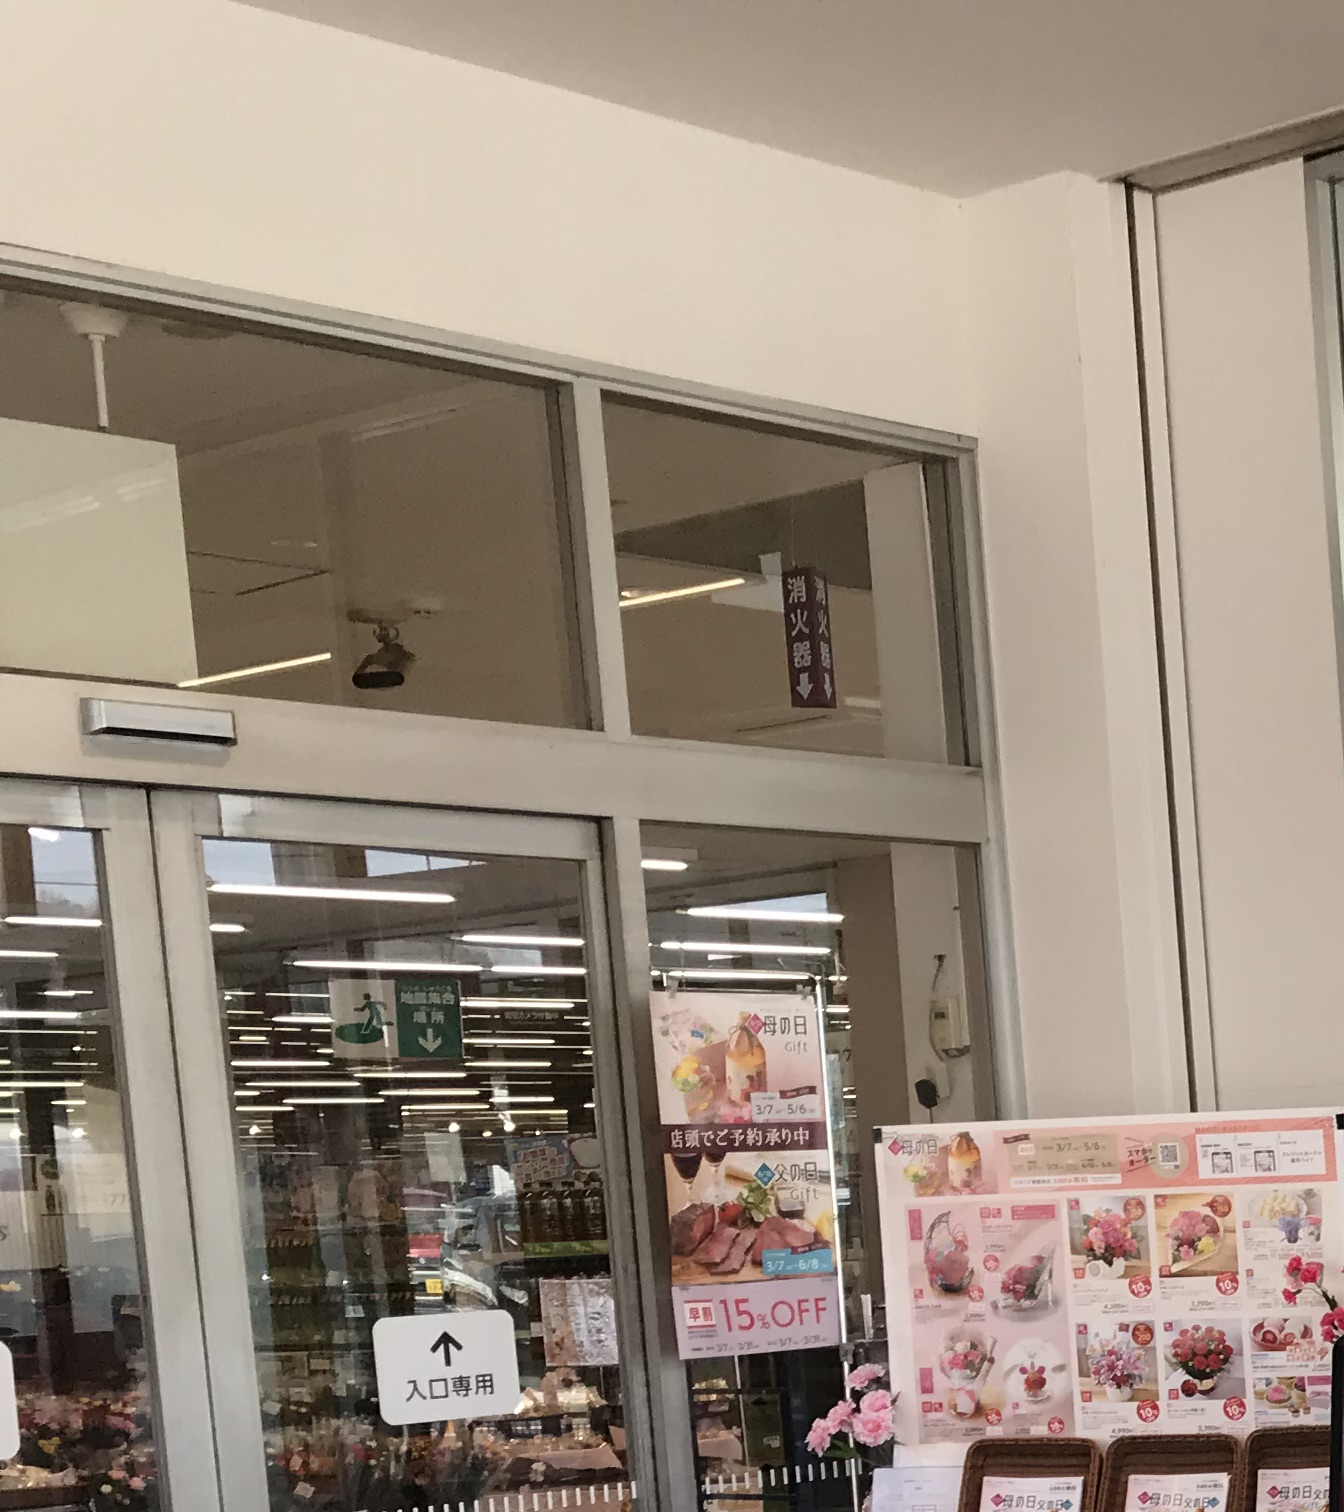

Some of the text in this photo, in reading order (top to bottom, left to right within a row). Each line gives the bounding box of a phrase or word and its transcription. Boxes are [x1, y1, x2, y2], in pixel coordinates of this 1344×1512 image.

[787, 576, 812, 669] 消火器
[814, 576, 832, 669] 消火器
[763, 1015, 808, 1036] 母の日
[784, 1041, 808, 1054] Gift
[787, 1103, 807, 1114] 5/6
[670, 1128, 810, 1149] 店頭でご予約承り中
[773, 1161, 818, 1182] 父の日
[790, 1187, 819, 1203] Gift
[766, 1261, 784, 1271] 3/7
[405, 1373, 495, 1403] 入口専用
